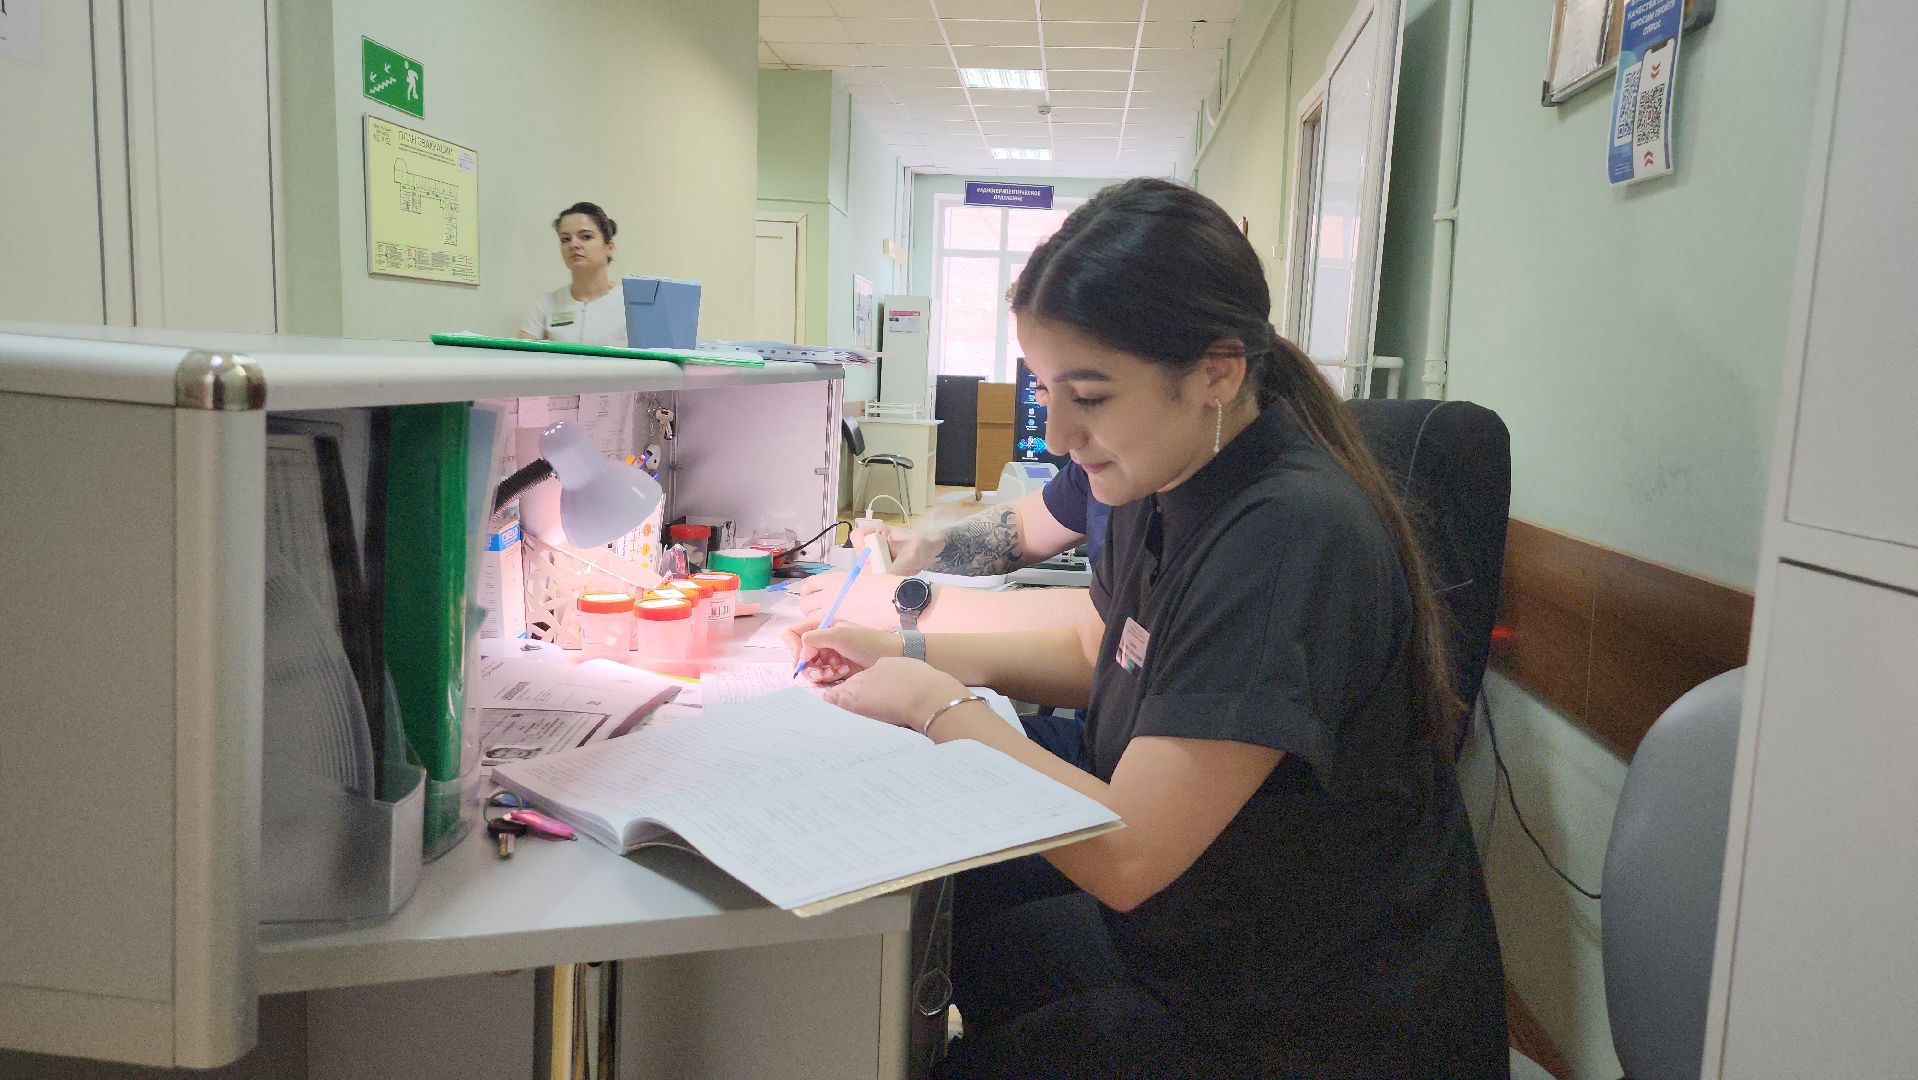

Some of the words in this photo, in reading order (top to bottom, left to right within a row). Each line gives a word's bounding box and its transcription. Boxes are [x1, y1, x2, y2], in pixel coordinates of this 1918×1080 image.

[1631, 12, 1654, 30] ПРОСИМ
[1642, 20, 1662, 35] ОПРОС
[398, 130, 416, 144] ПЛАН
[418, 136, 453, 155] ЭВАКУАЦИИ
